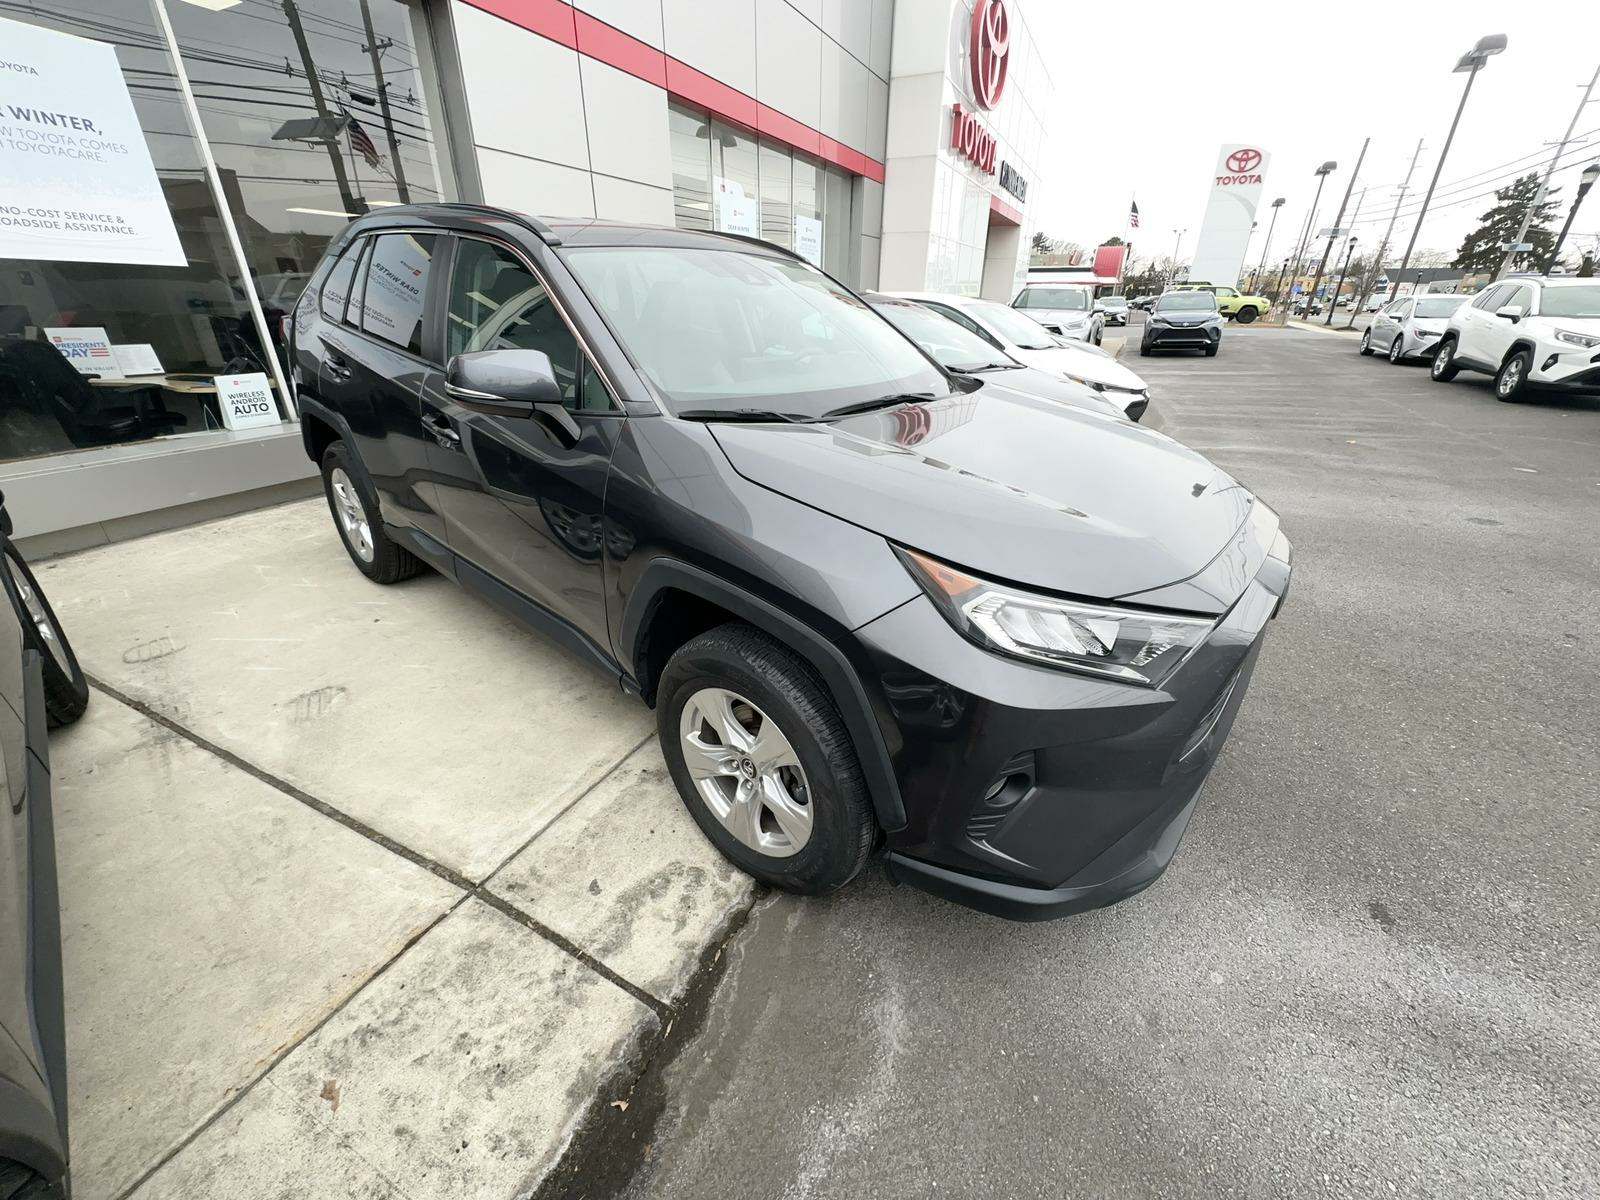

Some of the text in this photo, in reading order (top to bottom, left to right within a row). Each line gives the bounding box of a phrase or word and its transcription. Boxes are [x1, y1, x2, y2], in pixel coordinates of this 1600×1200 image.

[7, 104, 103, 136] WINTER,
[16, 127, 77, 146] TOYOTA
[79, 138, 128, 154] COMES
[951, 103, 997, 176] TOYOTA
[7, 139, 108, 163] TOYOTACARE.
[1216, 174, 1262, 186] TOYOTA
[64, 211, 113, 223] SERVICE
[117, 216, 125, 224] &
[64, 222, 138, 235] ASSISTANCE.
[61, 349, 88, 358] DAY
[227, 390, 265, 399] WIRELESS
[230, 396, 267, 405] ANDROID
[234, 402, 269, 415] AUTO
